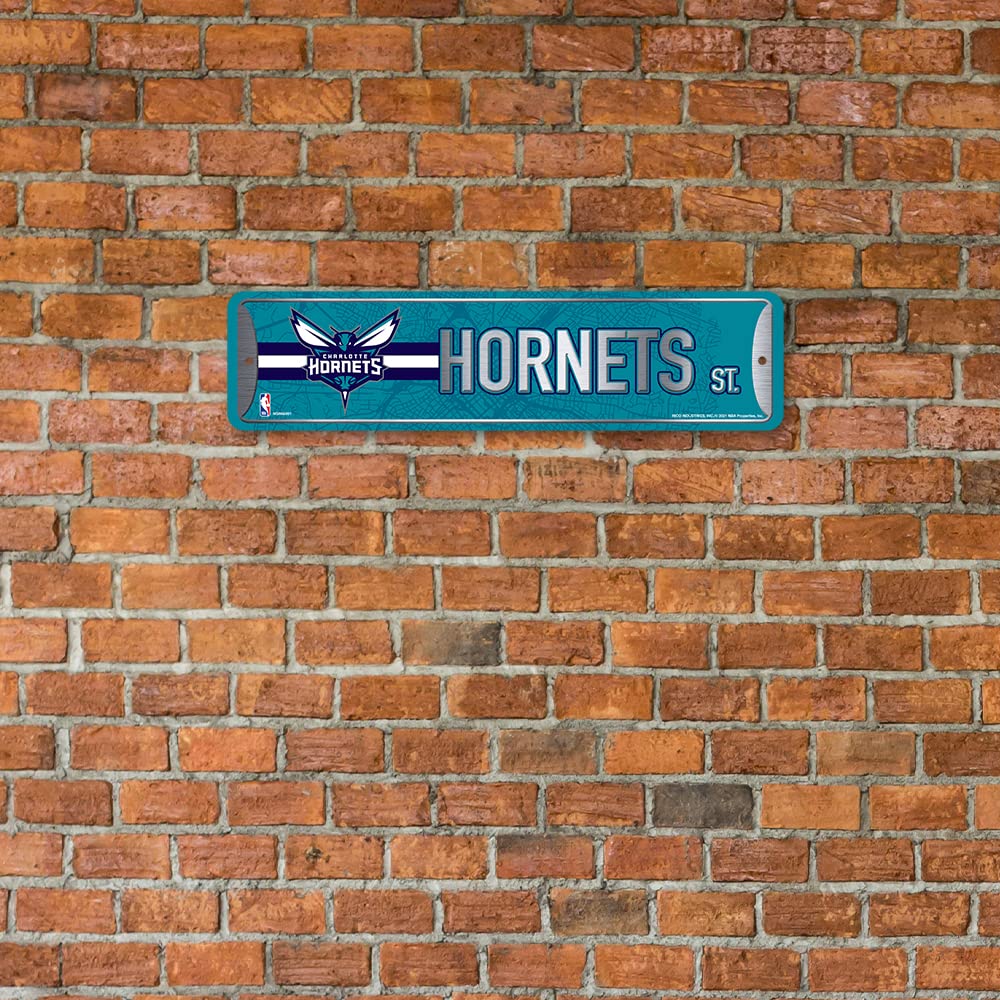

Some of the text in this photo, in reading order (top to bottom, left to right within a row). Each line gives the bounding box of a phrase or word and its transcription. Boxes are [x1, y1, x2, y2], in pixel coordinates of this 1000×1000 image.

[308, 357, 382, 376] HORNETS
[438, 328, 740, 394] HORNETS ST.
